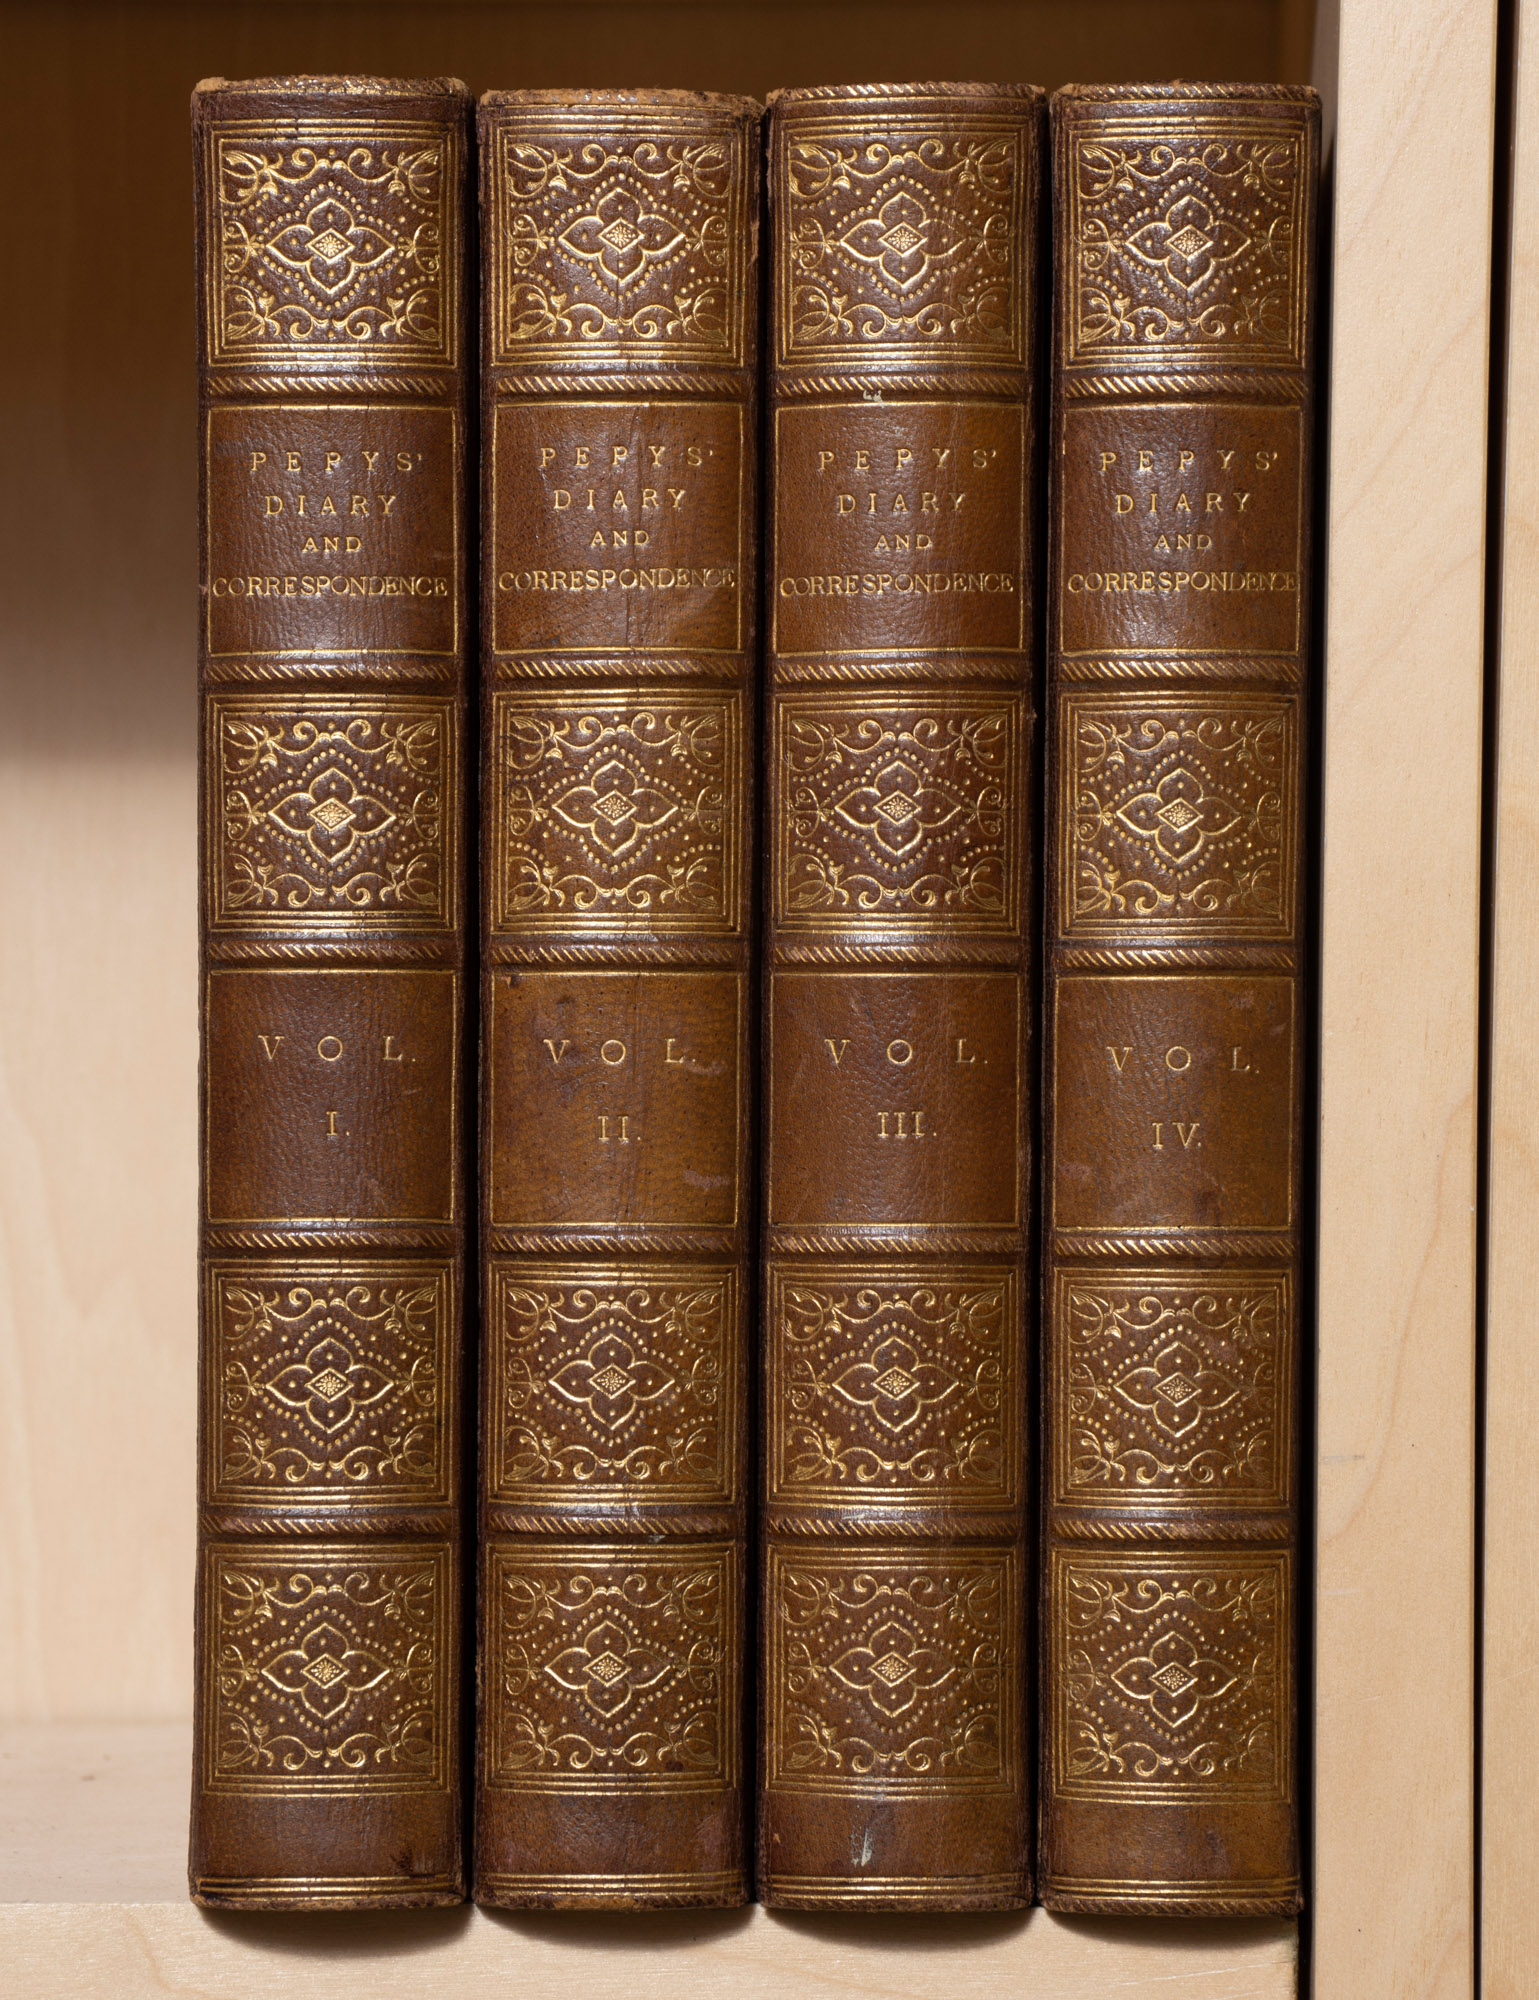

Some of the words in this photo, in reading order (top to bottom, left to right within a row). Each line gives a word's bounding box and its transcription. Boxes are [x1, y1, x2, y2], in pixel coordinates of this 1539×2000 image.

[251, 452, 422, 472] PEPYS'
[540, 446, 713, 467] PEPYS'
[818, 448, 997, 470] PEPYS'
[1100, 450, 1278, 471] PEPYS'
[265, 495, 396, 515] DIARY
[554, 488, 686, 509] DIARY
[838, 492, 966, 514] DIARY
[1115, 493, 1250, 513] DIARY
[302, 536, 363, 552] AND
[590, 530, 650, 546] AND
[874, 534, 933, 550] AND
[1155, 534, 1212, 550] AND
[212, 576, 448, 597] CORRESPONDENCE
[499, 568, 735, 590] CORRESPONDENCE
[780, 573, 1014, 597] CORRESPONDENCE
[1067, 571, 1297, 593] CORRESPONDENCE
[257, 1035, 416, 1062] VOL.
[543, 1038, 696, 1065] VOL.
[824, 1038, 988, 1064] VOL.
[1105, 1046, 1260, 1074] VOL.
[326, 1110, 350, 1136] I.
[598, 1115, 641, 1141] II.
[877, 1111, 937, 1137] III.
[1152, 1122, 1202, 1149] IV.
